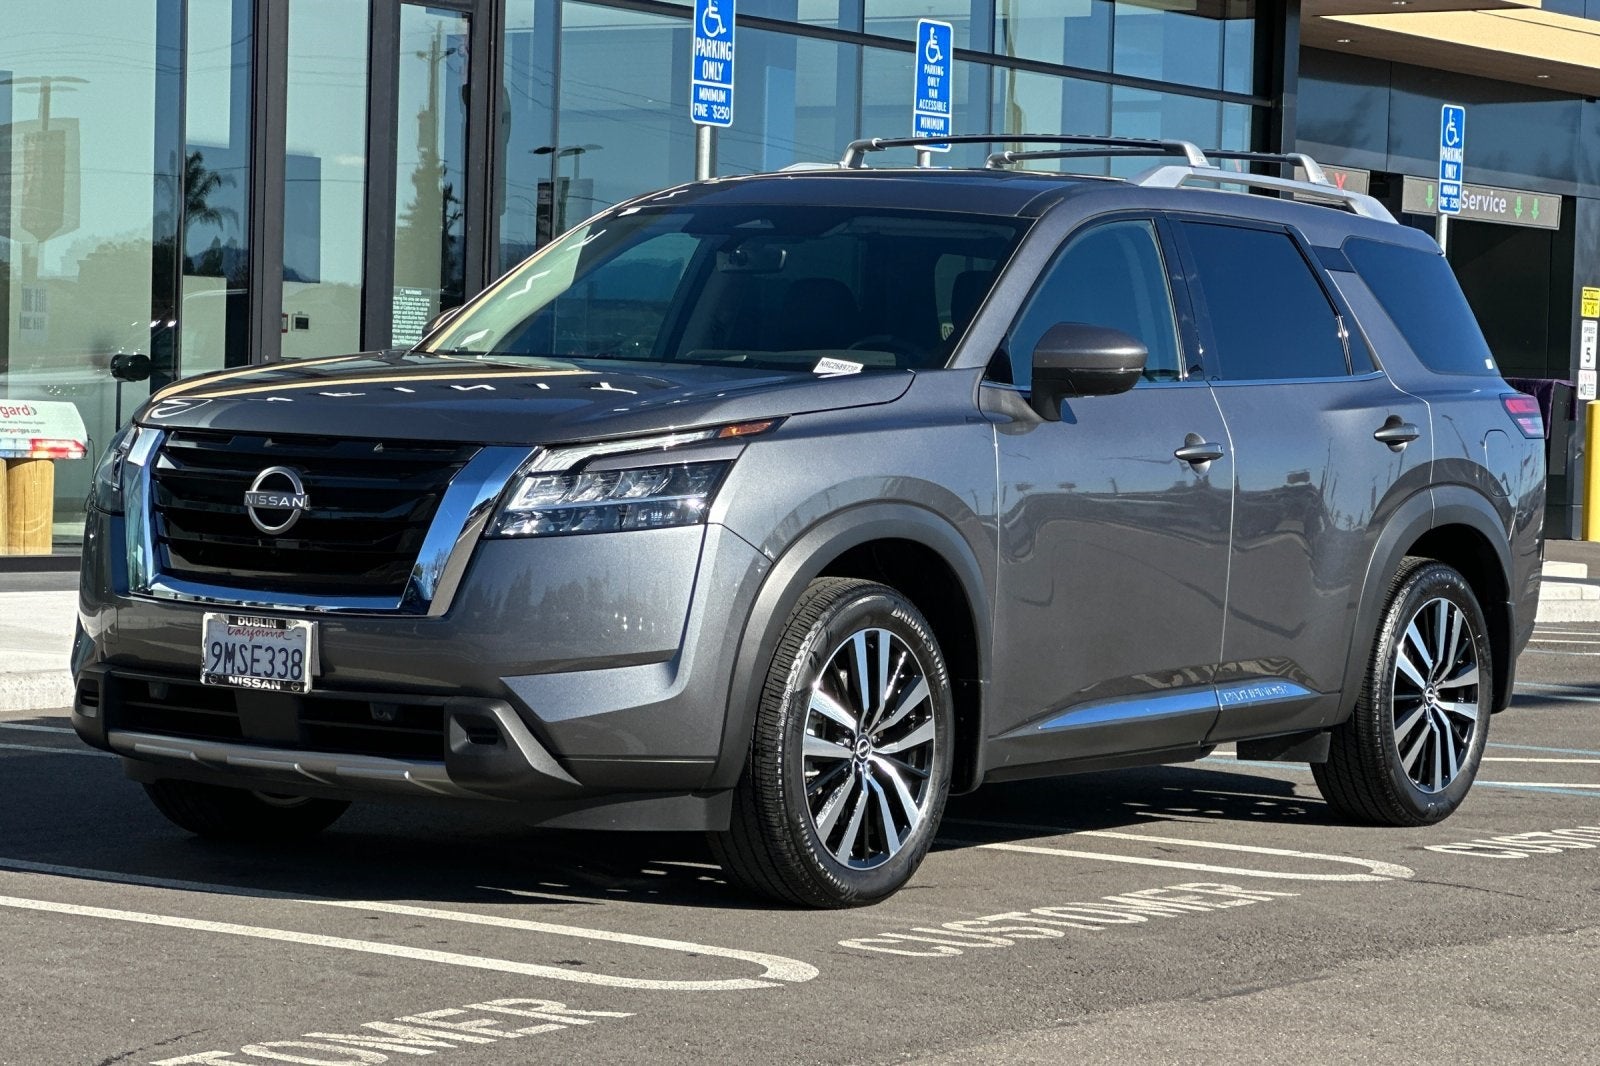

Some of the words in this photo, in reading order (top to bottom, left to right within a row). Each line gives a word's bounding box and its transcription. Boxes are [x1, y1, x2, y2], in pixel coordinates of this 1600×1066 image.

[696, 37, 732, 61] PARKING
[702, 60, 724, 81] ONLY
[924, 64, 944, 76] PARKING
[927, 76, 940, 87] ONLY
[699, 87, 726, 104] MINIMUM
[928, 88, 938, 99] VAN
[694, 102, 708, 117] FINE
[918, 99, 947, 112] ACCESSIBLE
[920, 116, 944, 130] MINIMUM
[1462, 189, 1506, 213] Service
[1585, 347, 1591, 363] 5
[0, 404, 30, 418] gard
[245, 494, 304, 508] NISSAN
[237, 616, 277, 628] DUBLIN
[228, 626, 289, 642] California
[210, 641, 303, 680] 9MSE338
[229, 676, 281, 690] NISSAN
[838, 882, 1301, 957] CUSTOMER
